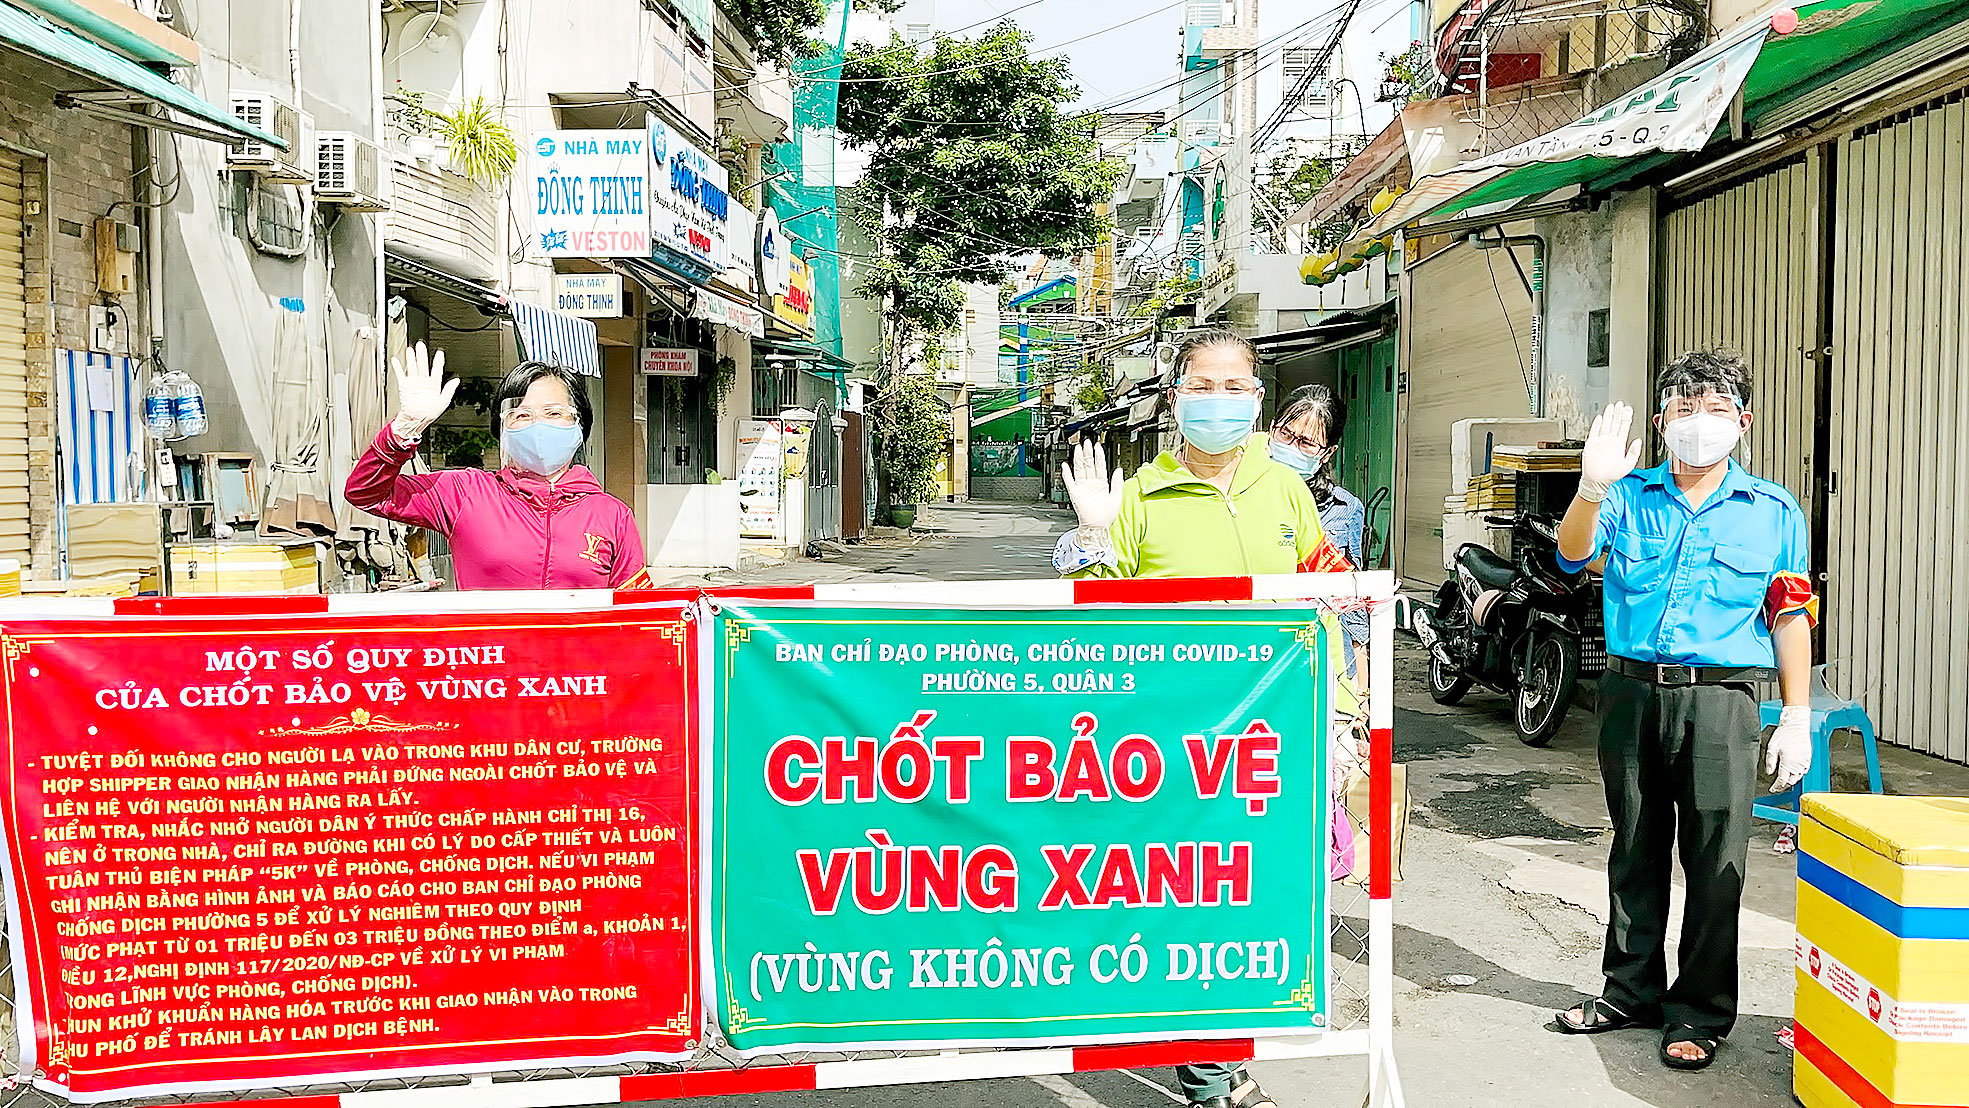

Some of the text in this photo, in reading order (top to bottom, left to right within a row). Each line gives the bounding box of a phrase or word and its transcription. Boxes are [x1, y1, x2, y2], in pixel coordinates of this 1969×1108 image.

[565, 137, 599, 155] NHÀ
[606, 140, 643, 155] MAY
[1632, 125, 1670, 146] Q.3
[572, 231, 645, 252] VESTON
[587, 278, 607, 288] MAY
[587, 294, 614, 312] THỊNH
[205, 640, 505, 675] MỘT SỐ QUY ĐỊNH
[776, 638, 1273, 665] BAN CHỈ ĐẠO PHÒNG, CHỐNG DỊCH COVID-19
[96, 675, 607, 709] CỦA CHỐT BẢO VỆ VÙNG XANH
[923, 669, 1135, 691] PHƯỜNG 5, QUẬN 3
[41, 751, 103, 771] TUYỆT
[111, 749, 144, 768] ĐỐI
[151, 751, 216, 767] KHÔNG
[222, 752, 261, 766] CHO
[268, 746, 325, 764] NGƯỜI
[332, 748, 355, 764] LẠ
[362, 744, 399, 761] VÀO
[404, 745, 464, 759] TRONG
[471, 743, 507, 757] KHU
[514, 739, 550, 756] DÂN
[556, 739, 585, 757] CƯ,
[591, 736, 662, 753] TRƯỜNG
[764, 710, 1281, 816] CHỐT BẢO VỆ
[43, 758, 657, 795] HỢP SHIPPER GIAO NHẬN HÀNG PHẢI ĐỨNG NGOÀI CHỐT BẢO VỆ VÀ
[44, 787, 419, 817] LIÊN HỆ VỚI NGƯỜI NHẬN HÀNG RA LẤY.
[44, 819, 96, 841] KIỂM
[101, 824, 145, 840] TRA,
[152, 817, 203, 837] NHẮC
[210, 817, 249, 835] NHỞ
[256, 817, 312, 833] NGƯỜI
[319, 815, 358, 832] DÂN
[364, 813, 376, 829] Ý
[383, 811, 432, 828] THỨC
[438, 808, 486, 826] CHẤP
[493, 808, 541, 825] HÀNH
[548, 804, 577, 822] CHỈ
[582, 809, 611, 824] THỊ
[619, 807, 645, 822] 16,
[796, 829, 1252, 915] VÙNG XANH
[51, 872, 641, 913] GHI NHẬN BẰNG HÌNH ẢNH VÀ BÁO CÁO CHO BAN CHỈ ĐẠO PHÒNG
[751, 933, 1290, 1000] (VÙNG KHÔNG CÓ DỊCH)
[121, 986, 166, 1005] LĨNH
[173, 983, 210, 1006] VỰC
[217, 981, 285, 998] PHÒNG,
[292, 974, 355, 994] CHỐNG
[362, 975, 417, 992] DỊCH).
[109, 1007, 152, 1030] KHỬ
[158, 1005, 223, 1024] KHUẨN
[230, 1004, 280, 1020] HÀNG
[287, 999, 326, 1018] HÓA
[331, 996, 393, 1014] TRƯỚC
[399, 997, 430, 1010] KHI
[436, 993, 478, 1008] GIAO
[484, 988, 532, 1006] NHẬN
[538, 986, 573, 1002] VÀO
[579, 986, 637, 1001] TRONG
